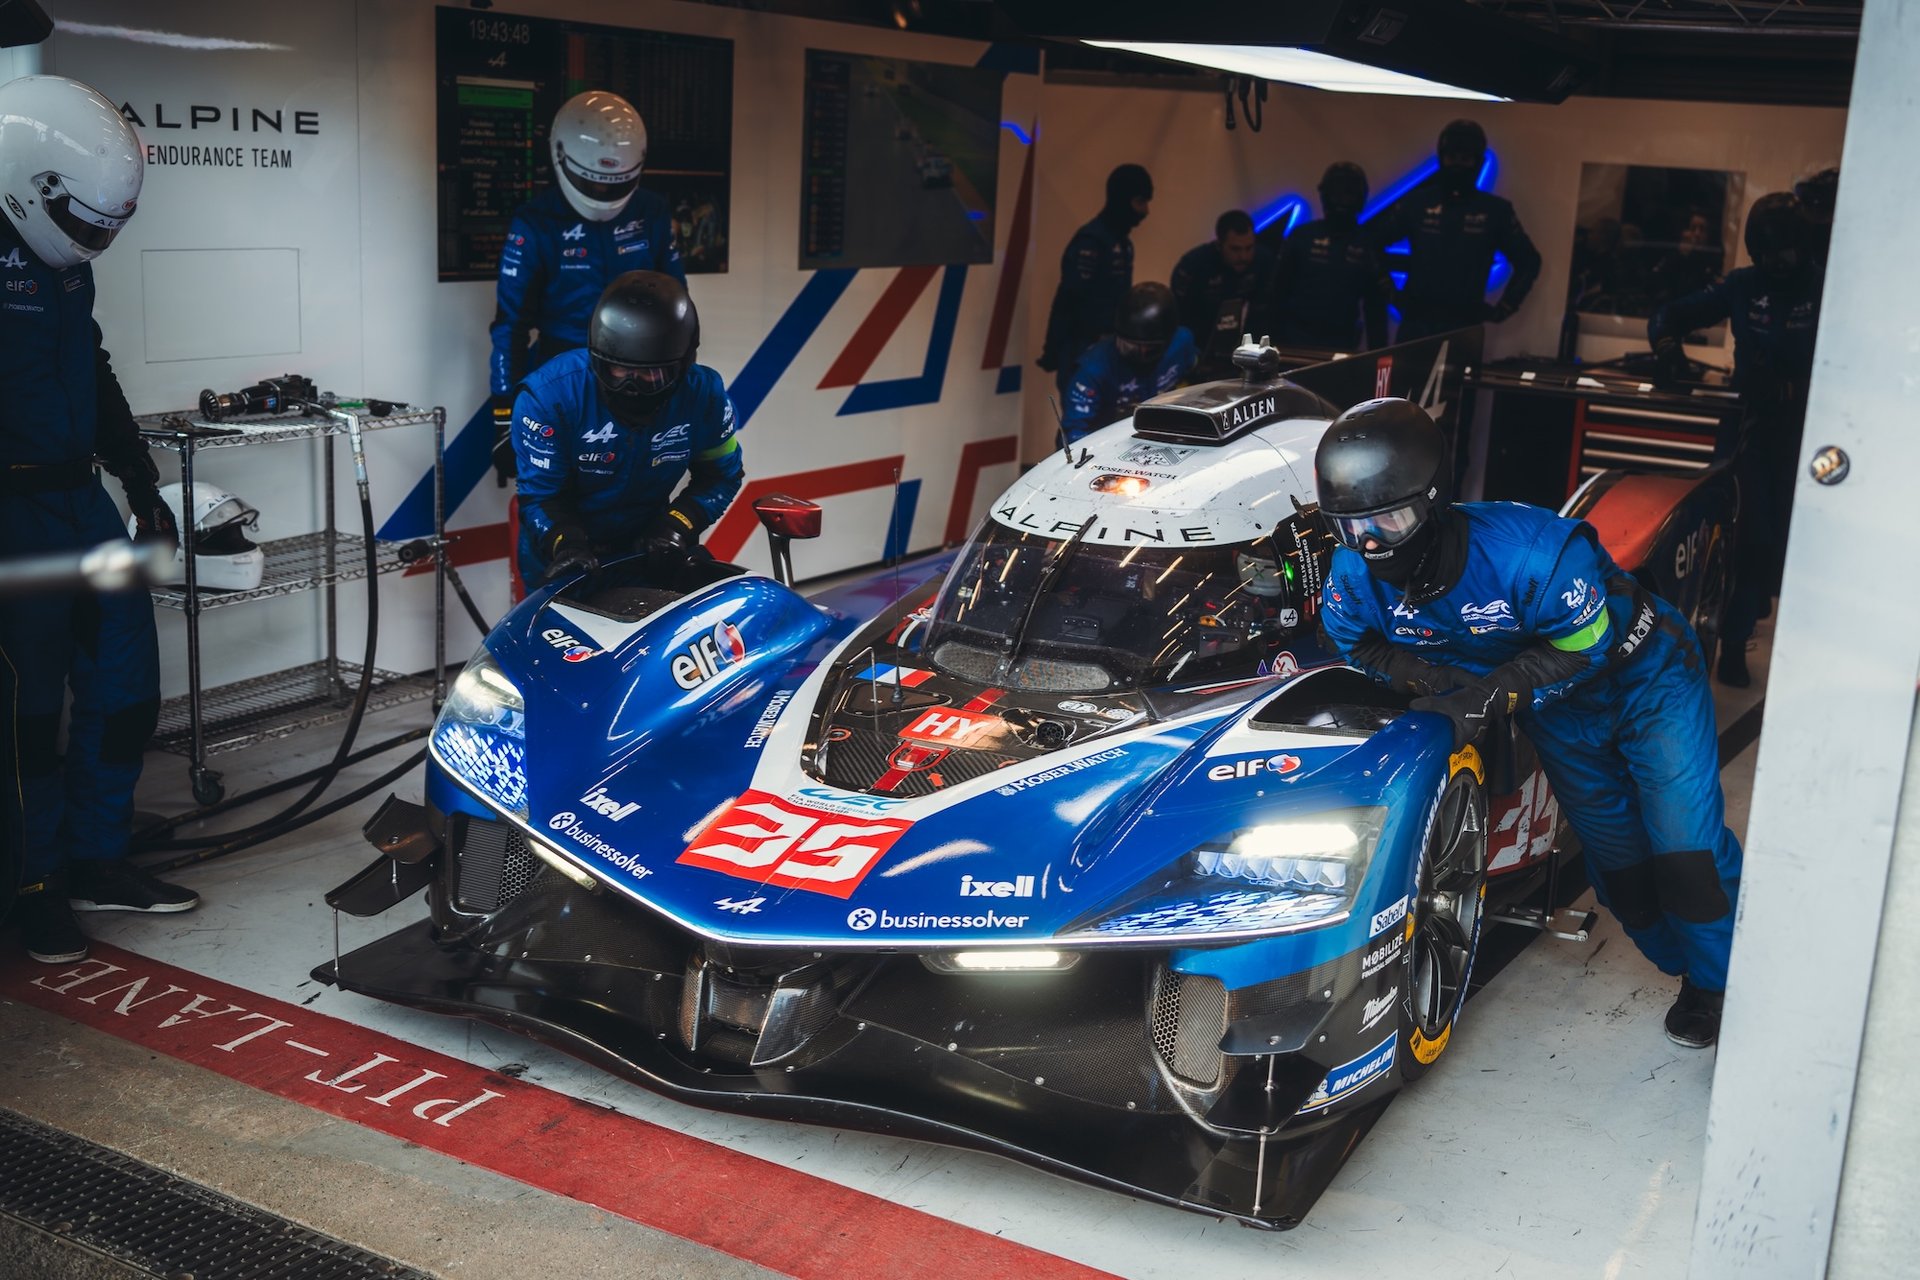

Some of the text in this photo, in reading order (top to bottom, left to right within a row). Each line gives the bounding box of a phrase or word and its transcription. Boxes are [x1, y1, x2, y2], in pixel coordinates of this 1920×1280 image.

[469, 19, 530, 44] 19:43:48
[120, 101, 320, 135] ALPINE
[147, 144, 292, 169] ENDURANCE TEAM
[6, 280, 25, 291] elf
[522, 416, 541, 432] elf
[1233, 397, 1275, 425] ALTEN
[578, 452, 602, 462] elf
[997, 506, 1216, 543] ALPINE
[541, 629, 580, 649] elf
[671, 635, 720, 690] elf
[911, 712, 991, 740] HY
[1015, 748, 1130, 792] MOSER.WATCH
[1208, 758, 1264, 781] elf
[579, 787, 642, 822] ixell
[787, 797, 850, 814] CHAMPIONSHIP
[790, 793, 804, 802] FIA
[806, 799, 835, 808] WORLD
[798, 788, 911, 811] WEC
[564, 820, 654, 880] businessolver
[689, 801, 904, 884] 35
[959, 874, 1035, 898] ixell
[879, 909, 1030, 928] businessolver
[1374, 900, 1405, 933] Sabelt
[30, 958, 506, 1128] PIT-LANE
[1331, 1046, 1395, 1093] MICHELIN
